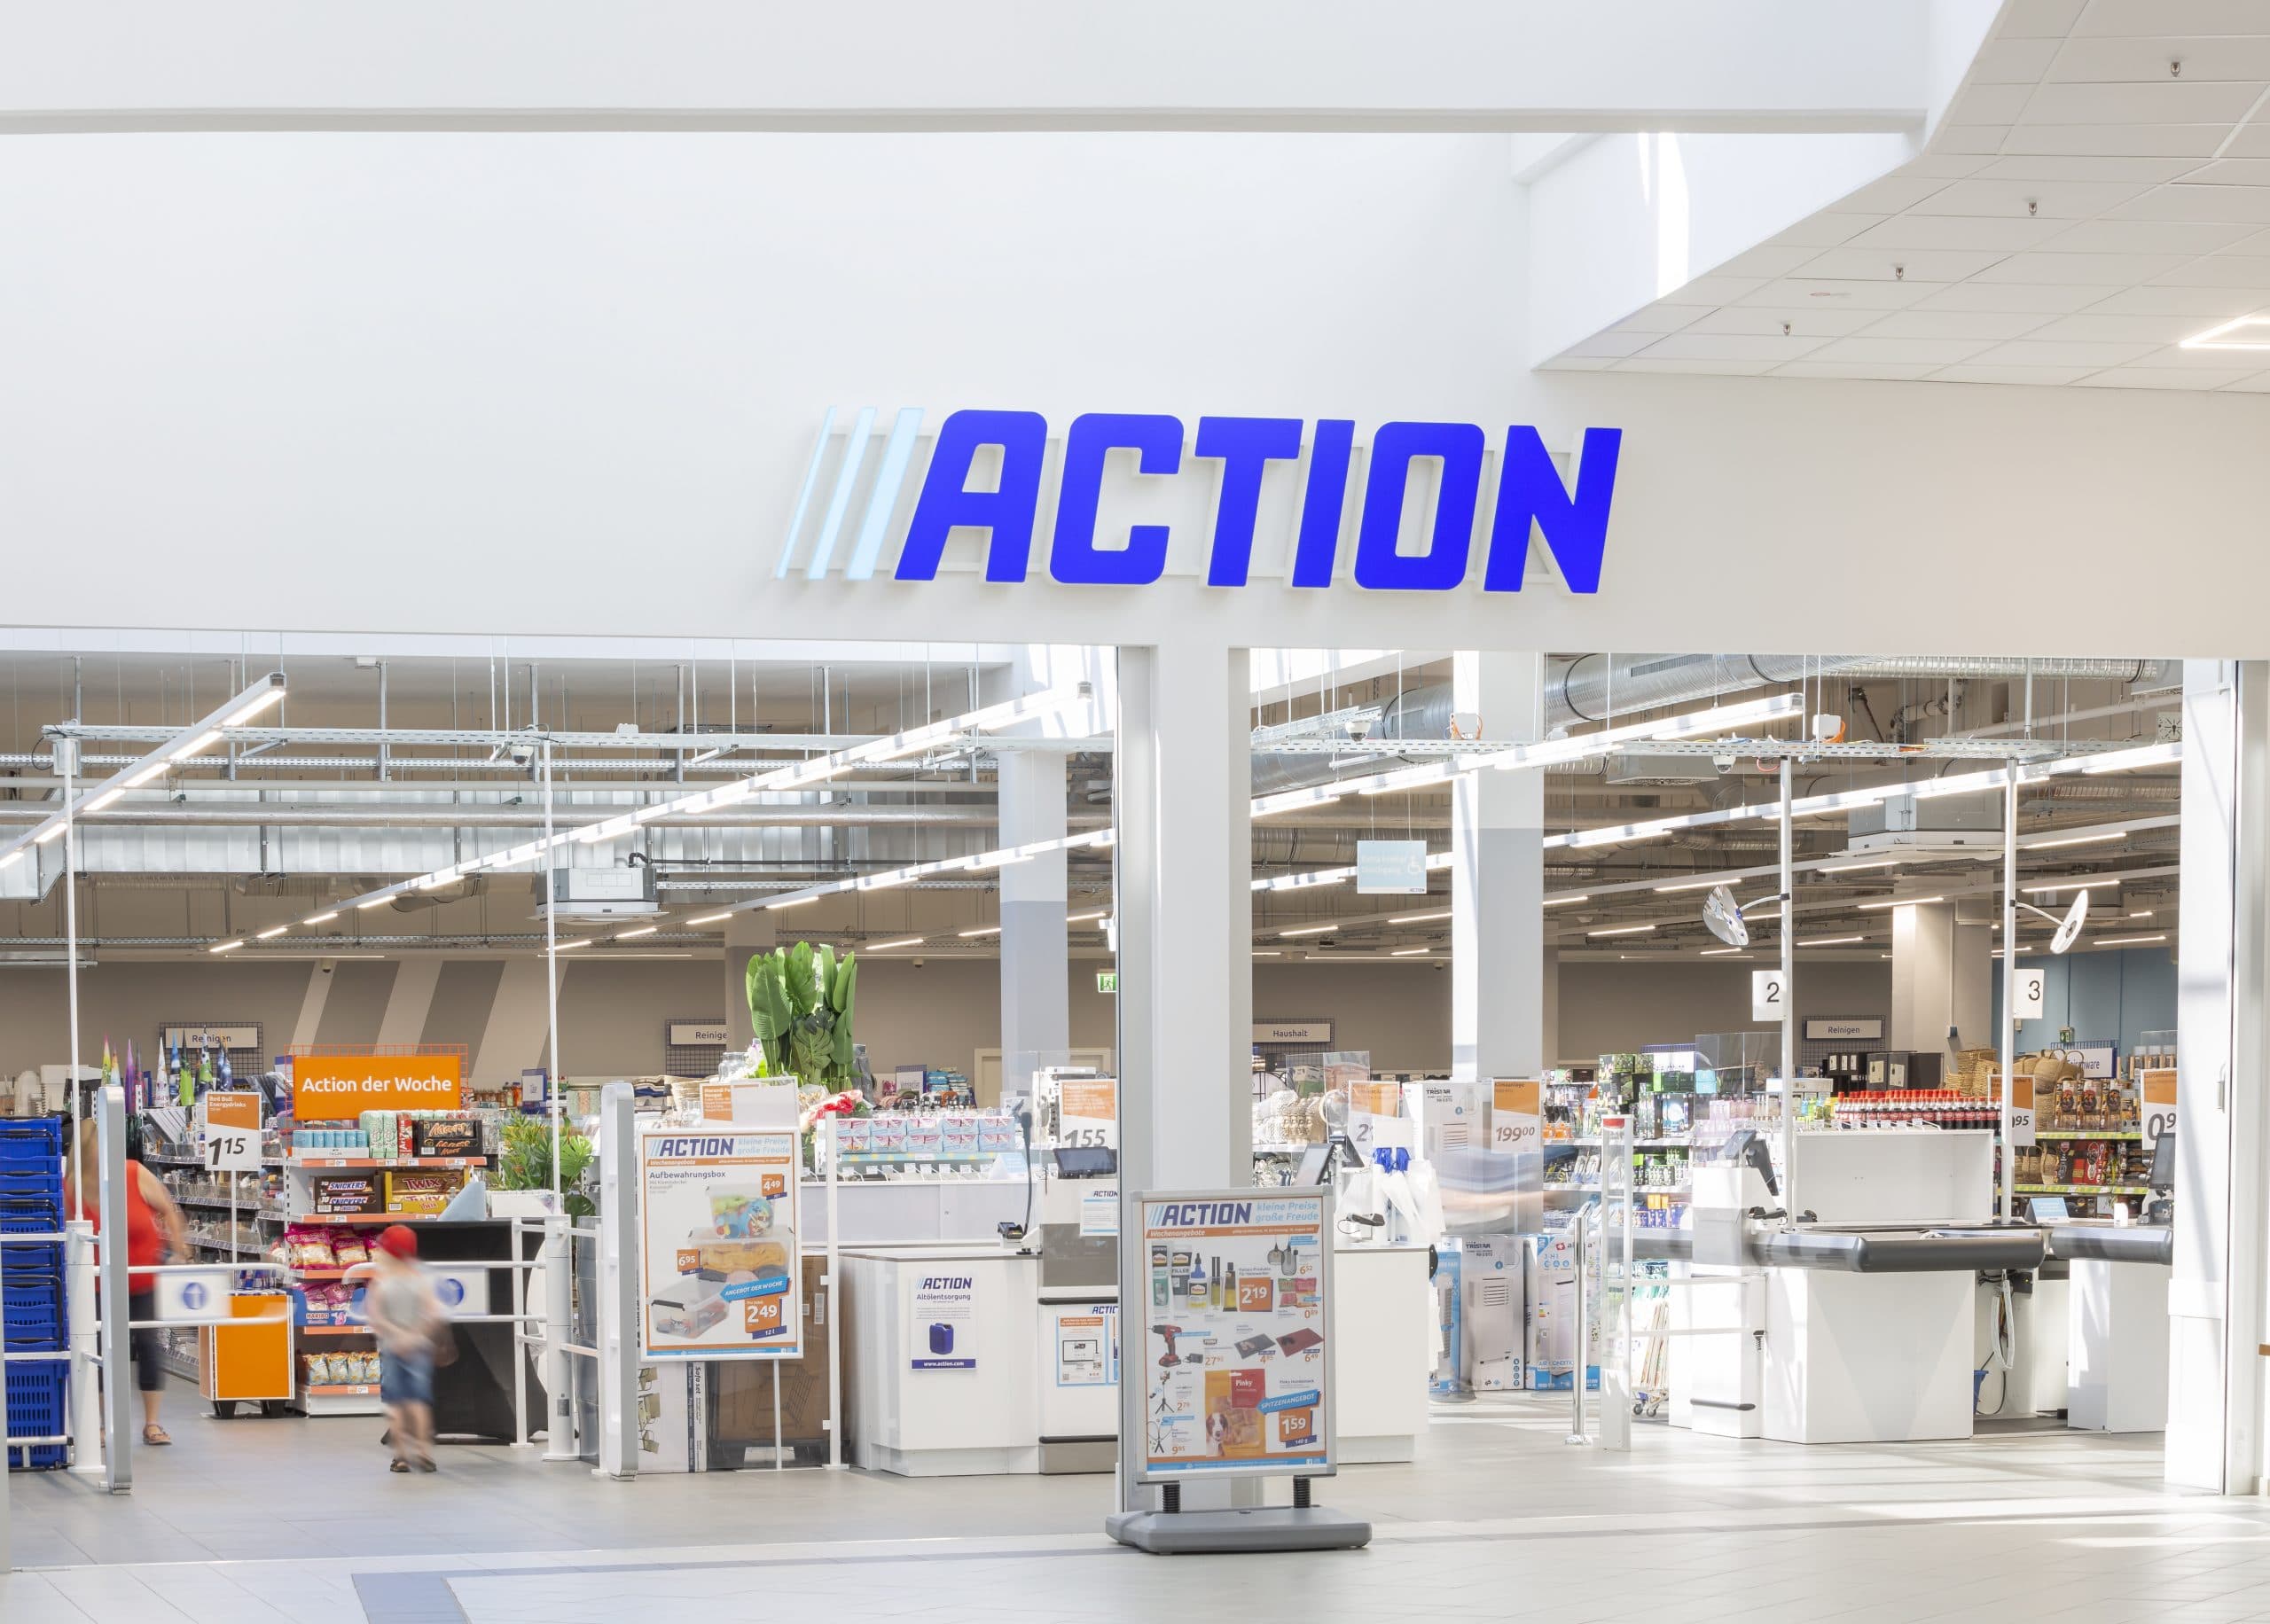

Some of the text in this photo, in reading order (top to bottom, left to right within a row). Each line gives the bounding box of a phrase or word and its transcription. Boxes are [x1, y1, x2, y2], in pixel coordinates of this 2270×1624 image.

[895, 409, 1622, 594] ACTION
[1766, 981, 1780, 1003] 2
[2028, 980, 2040, 1001] 3
[695, 1031, 727, 1040] Reinige
[1828, 1026, 1860, 1035] Reinigen
[192, 1035, 231, 1043] Renigen
[301, 1074, 452, 1092] Action der Woche
[2011, 1115, 2030, 1128] 95
[2148, 1113, 2177, 1141] 09
[1496, 1127, 1535, 1142] 19900
[659, 1138, 735, 1157] ACTION
[649, 1171, 726, 1180] Aufbewahrungsbox
[329, 1182, 366, 1191] SNICKERS
[763, 1180, 781, 1191] 449
[1256, 1201, 1318, 1212] kleine Preise
[1162, 1203, 1252, 1226] ACTION
[1256, 1212, 1319, 1223] große Freude
[1150, 1229, 1206, 1238] Wochenangebote
[678, 1254, 696, 1267] 695
[724, 1285, 751, 1297] ANGEBOT
[763, 1280, 784, 1290] WOCHE
[922, 1277, 973, 1290] ACTION
[1241, 1286, 1268, 1304] 219
[747, 1304, 778, 1323] 249
[1261, 1393, 1315, 1409] SPITZENANGEBOT
[1282, 1417, 1306, 1435] 159
